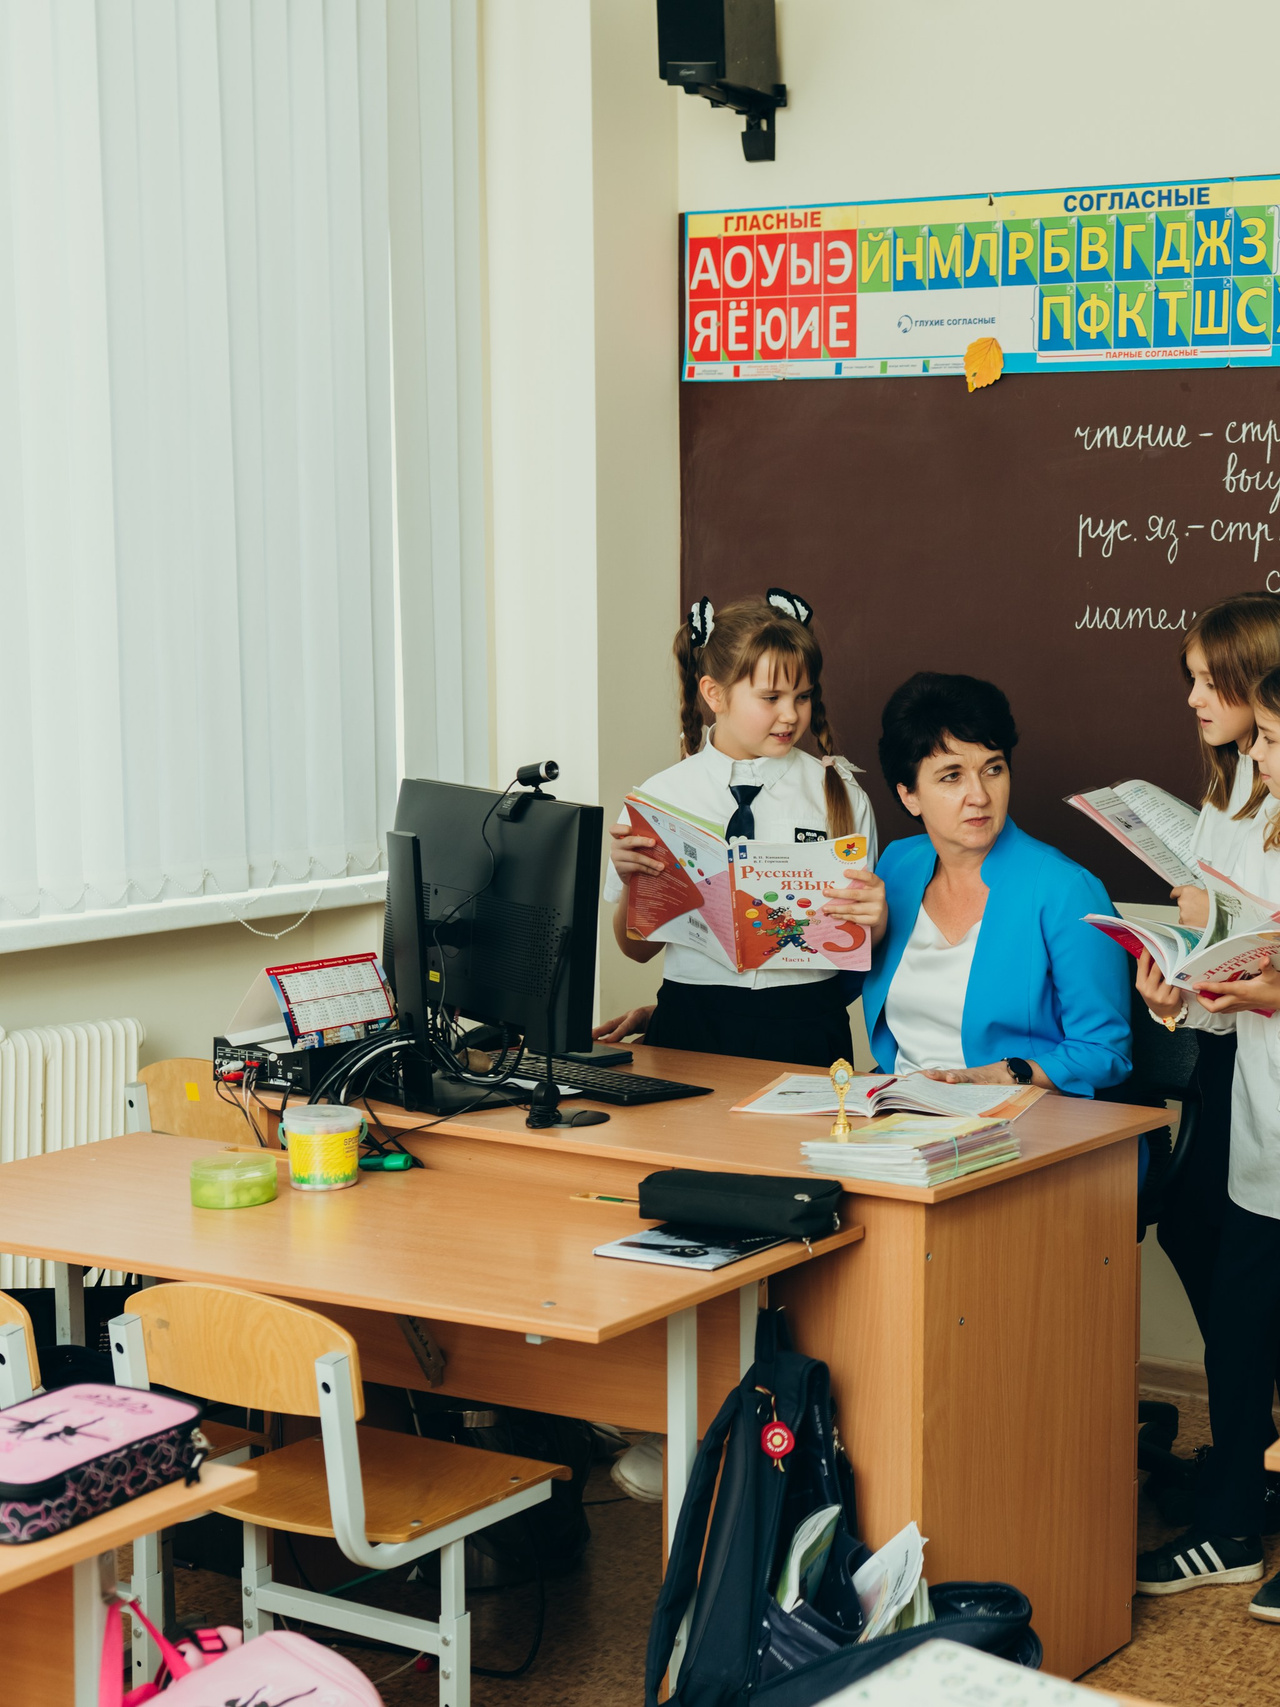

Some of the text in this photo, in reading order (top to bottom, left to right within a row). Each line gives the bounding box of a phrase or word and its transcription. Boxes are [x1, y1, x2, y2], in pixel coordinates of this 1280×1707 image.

[1063, 187, 1211, 213] СОГЛАСНЫЕ
[724, 211, 822, 232] ГЛАСНЫЕ
[914, 317, 996, 327] ГЛУХИЕ СОГЛАСНЫЕ
[1105, 348, 1199, 359] ПАРНЫЕ СОГЛАСНЫЕ
[1074, 423, 1192, 451] чтение
[740, 865, 813, 881] Русский
